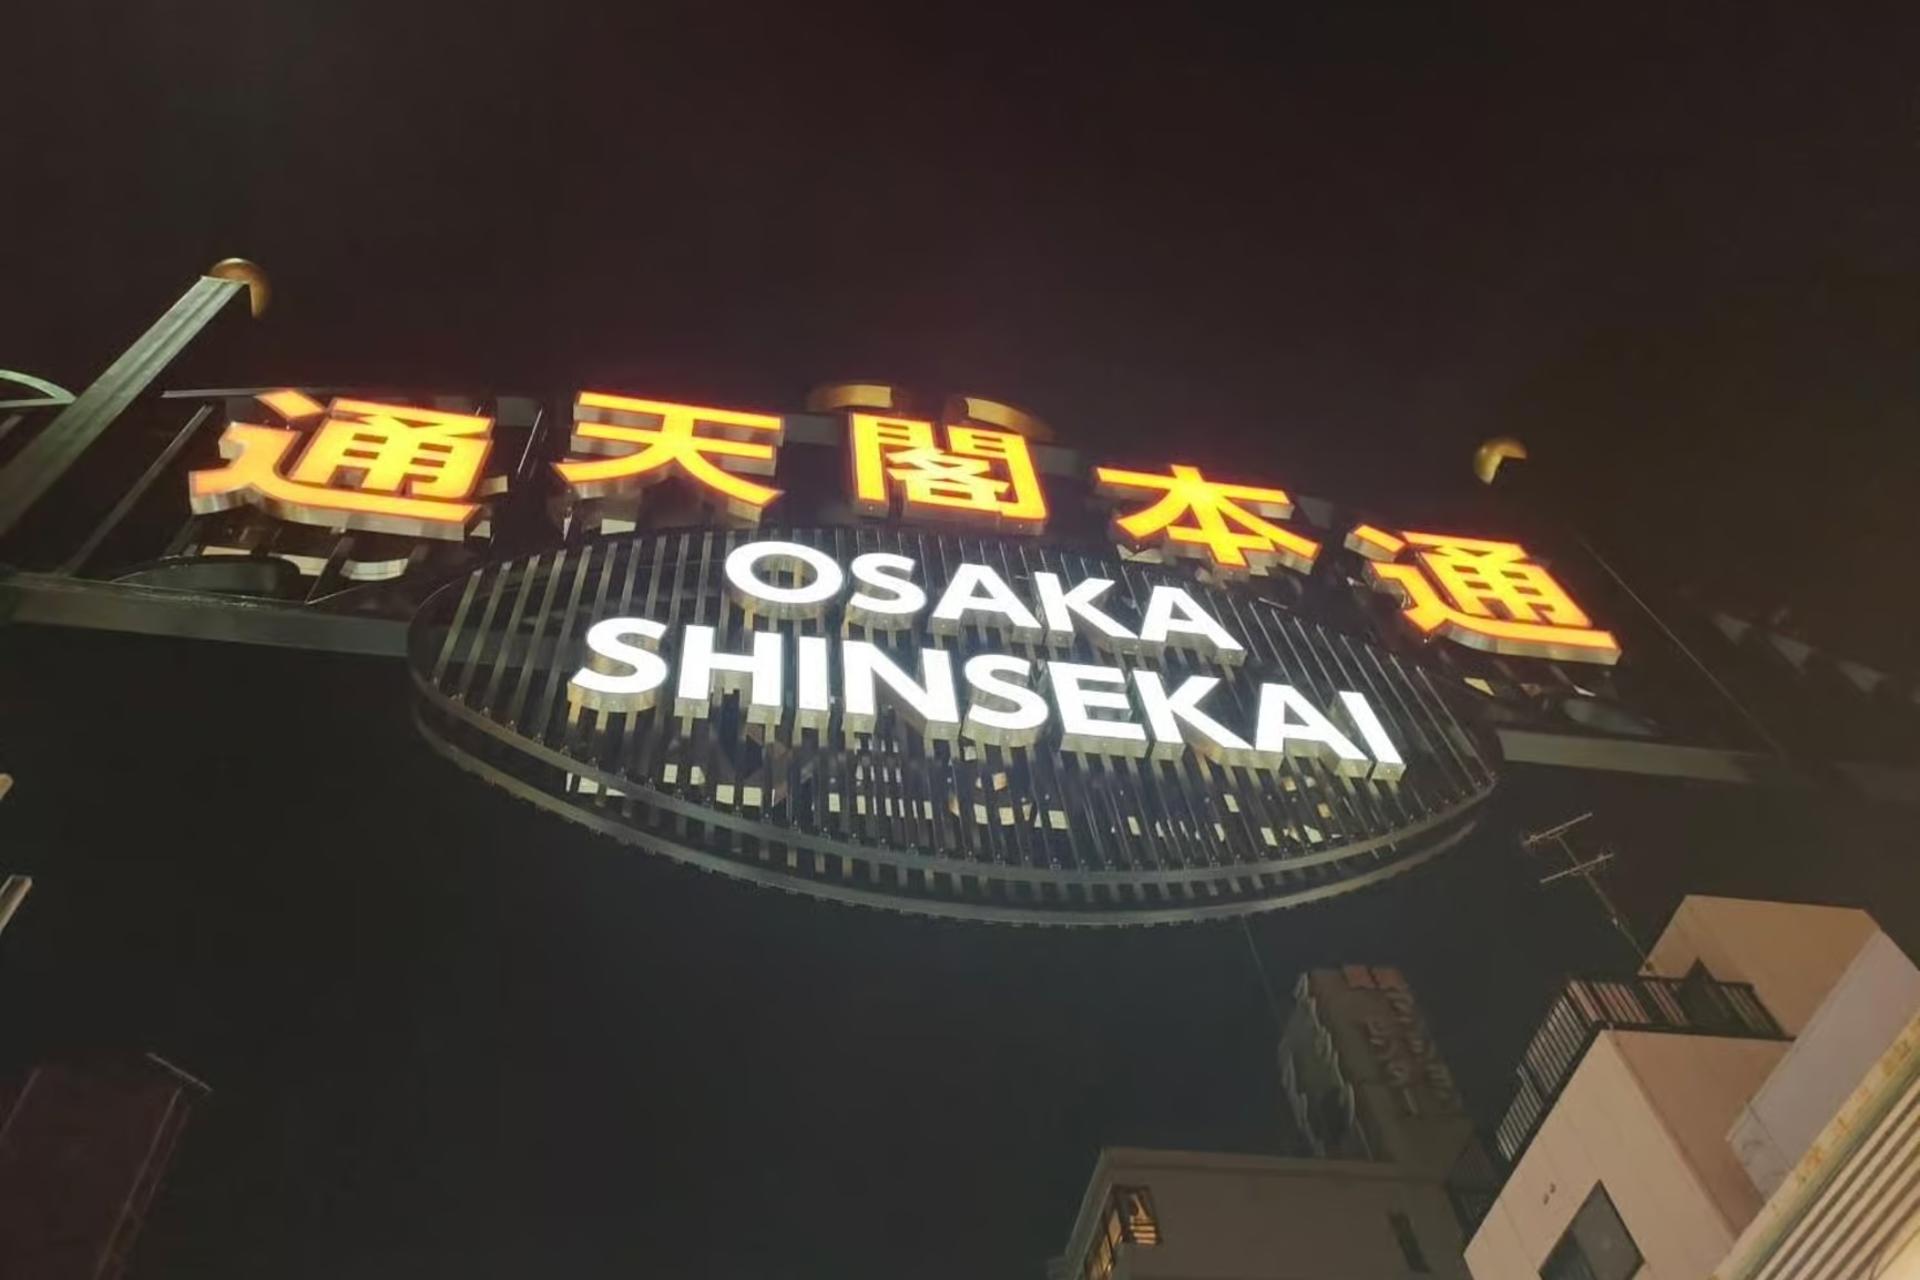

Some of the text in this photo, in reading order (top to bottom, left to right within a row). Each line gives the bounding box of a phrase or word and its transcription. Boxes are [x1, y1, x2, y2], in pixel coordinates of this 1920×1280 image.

[189, 389, 1621, 660] 通天閣本通
[725, 540, 1245, 656] OSAKA
[568, 616, 1405, 772] SHINSEKAI
